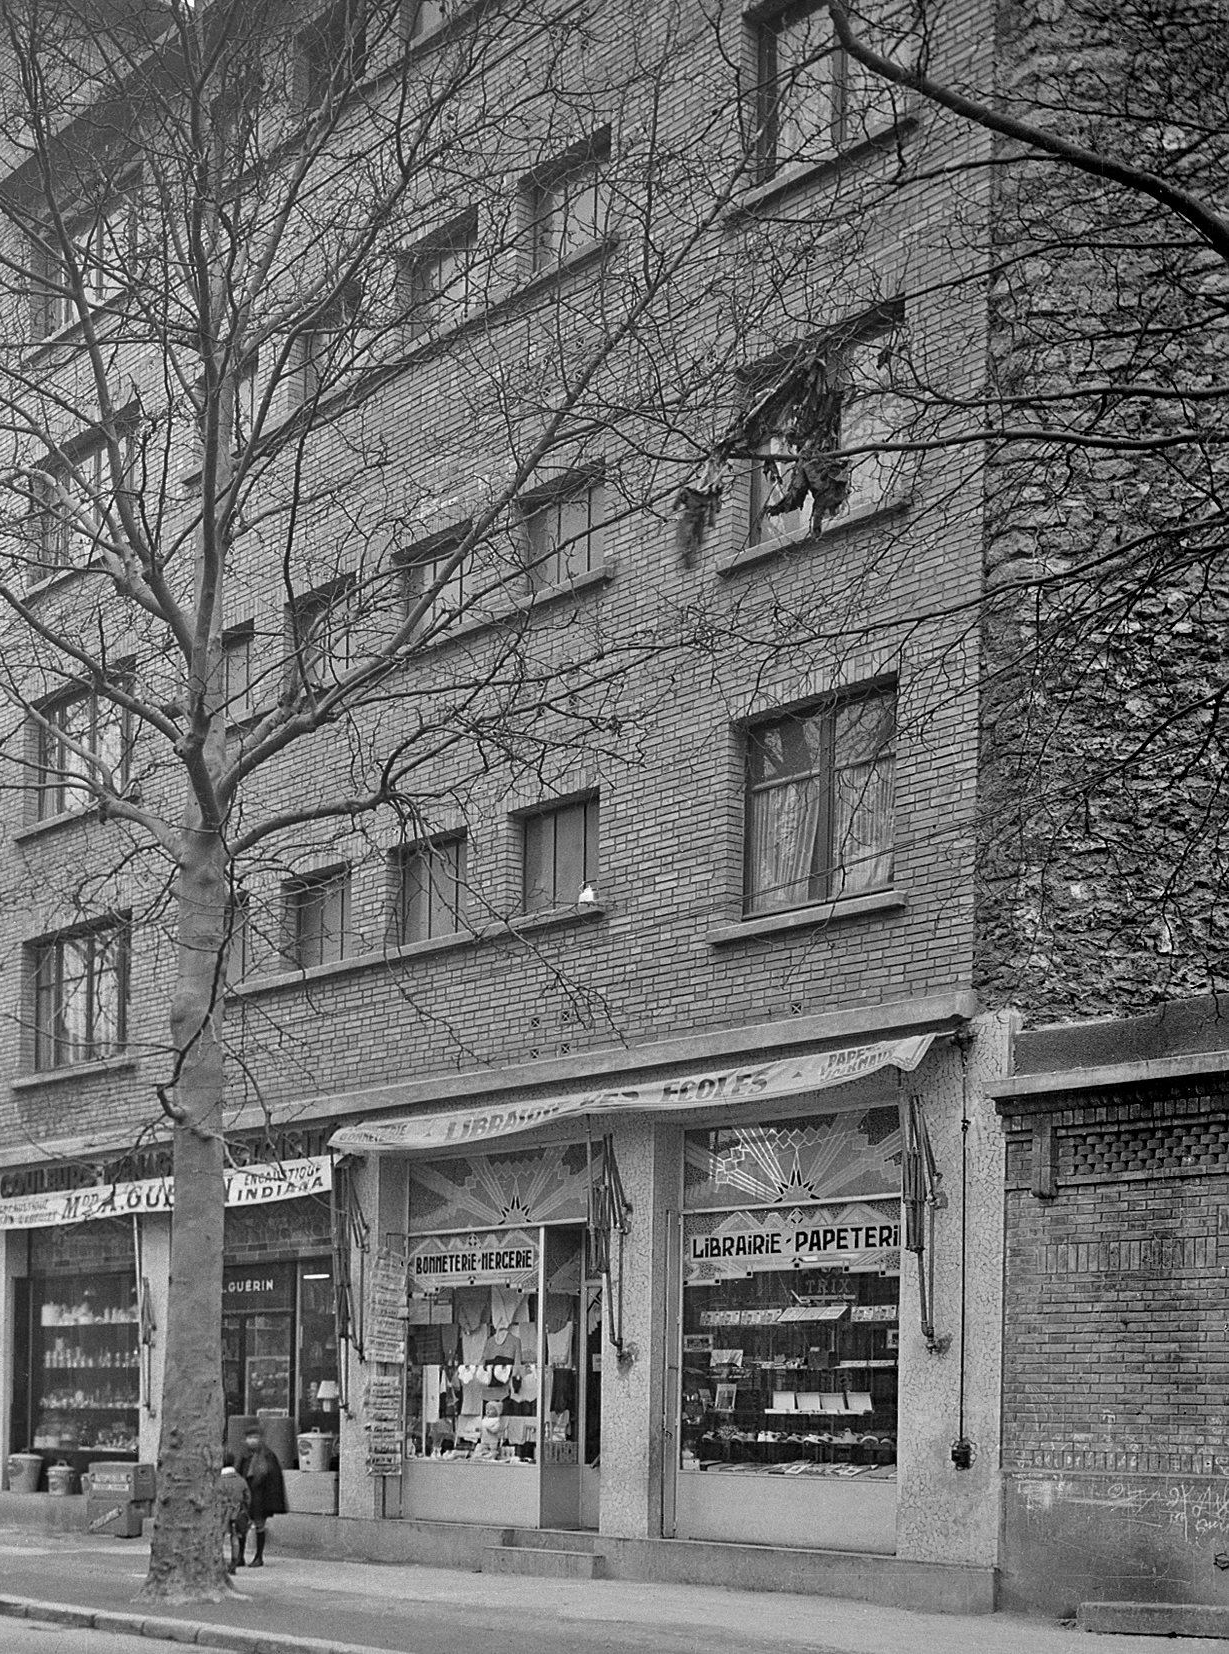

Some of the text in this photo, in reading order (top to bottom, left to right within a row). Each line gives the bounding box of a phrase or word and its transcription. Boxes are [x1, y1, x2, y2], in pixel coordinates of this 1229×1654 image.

[237, 1176, 323, 1201] INDIANA
[795, 1224, 902, 1253] PAPETERi
[805, 1278, 851, 1294] TRIX
